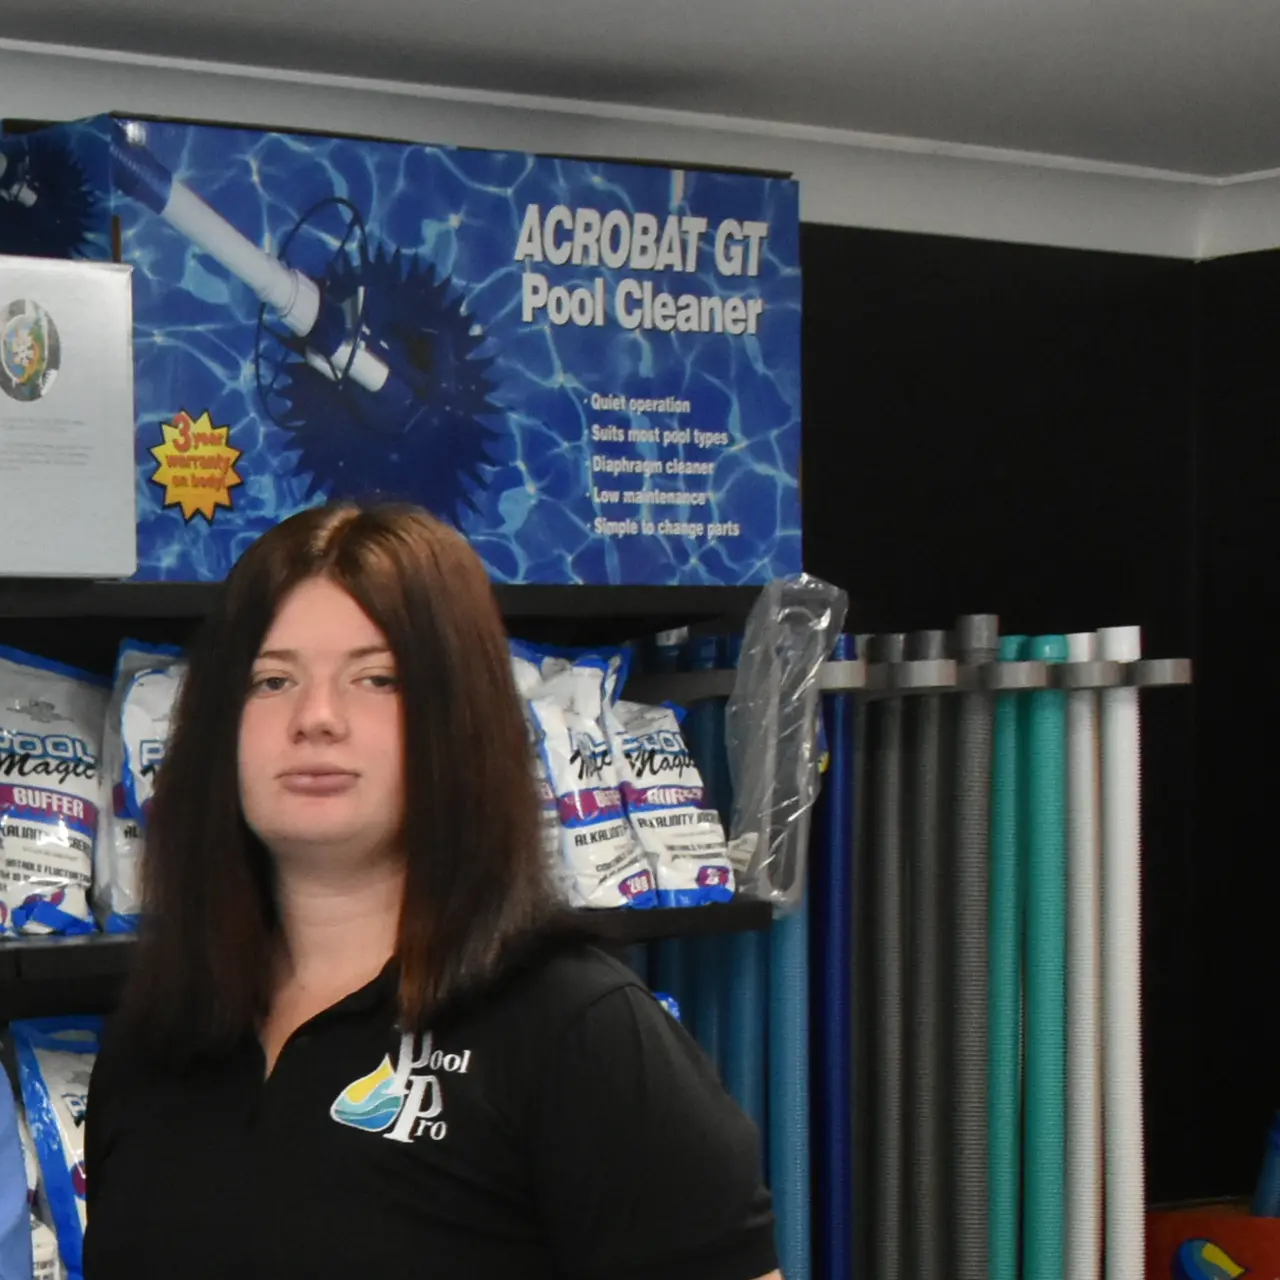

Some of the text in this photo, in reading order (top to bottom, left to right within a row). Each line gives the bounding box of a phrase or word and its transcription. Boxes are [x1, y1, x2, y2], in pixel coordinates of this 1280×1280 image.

[514, 204, 769, 278] ACROBAT GT
[520, 272, 763, 336] Pool Cleaner
[591, 392, 691, 416] Quiet operation
[172, 413, 192, 453] 3
[591, 424, 729, 448] Suits most pool types
[592, 455, 715, 478] Diaphragm cleaner
[593, 486, 707, 505] Low maintenance
[594, 516, 740, 539] Simple to change parts
[12, 786, 84, 819] BUFFER
[380, 1031, 472, 1096] Pool
[382, 1074, 448, 1143] Pro
